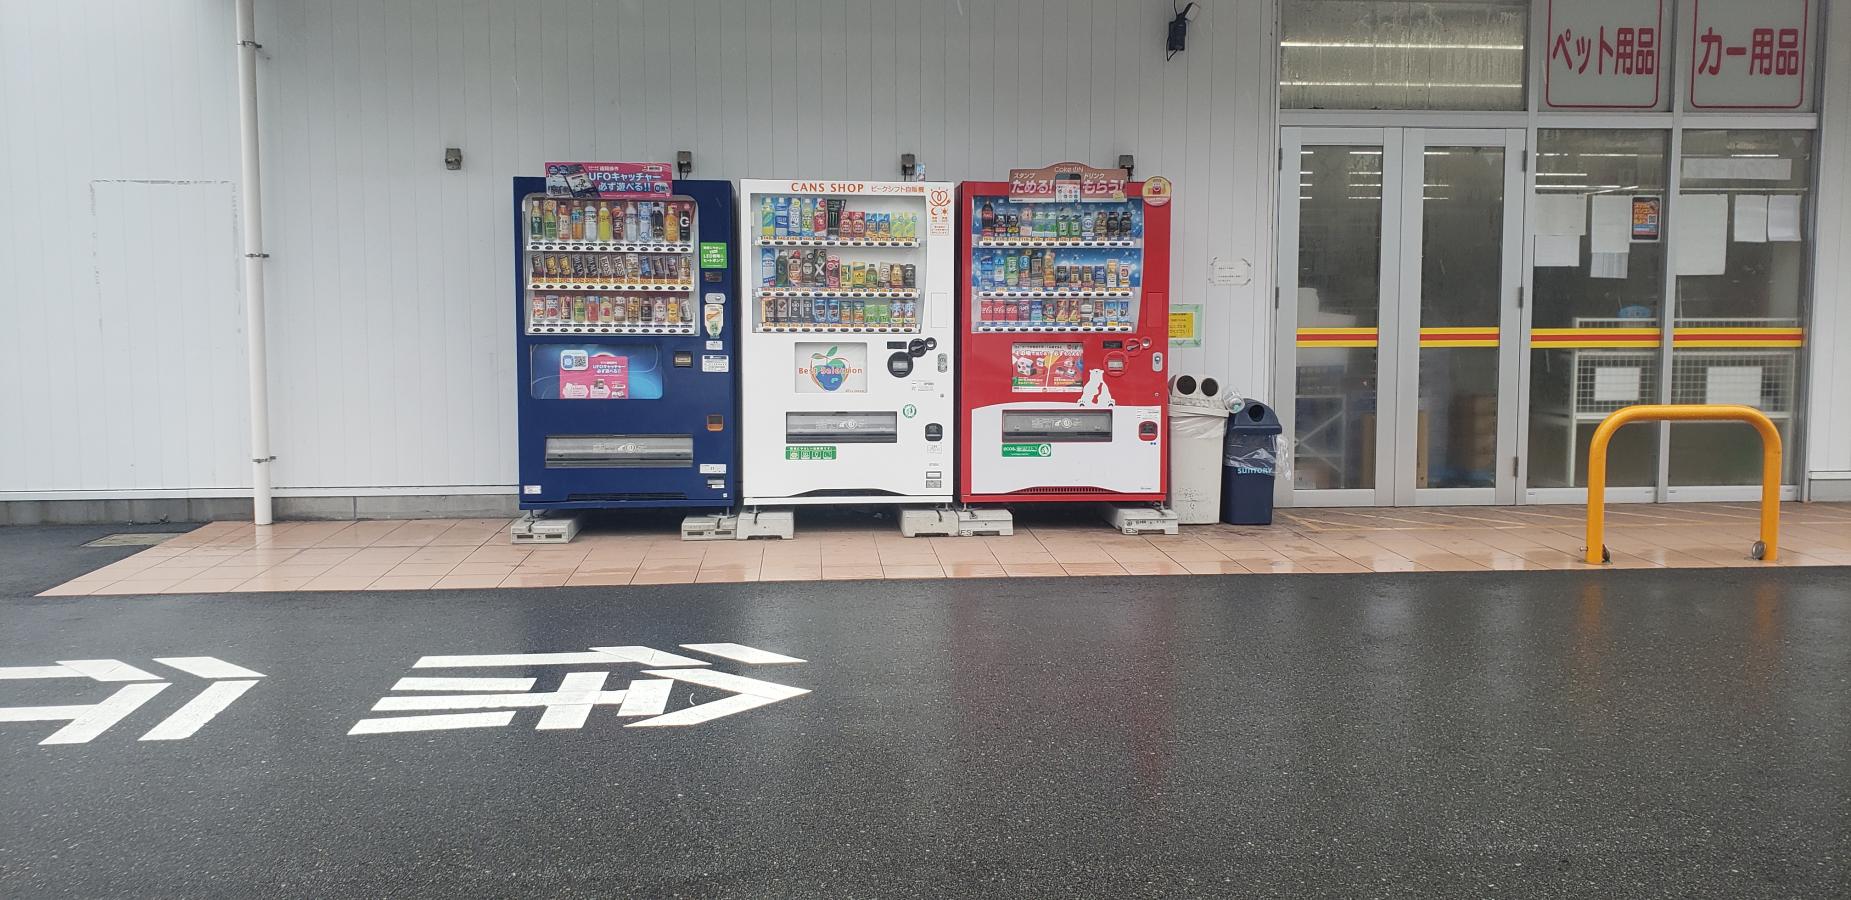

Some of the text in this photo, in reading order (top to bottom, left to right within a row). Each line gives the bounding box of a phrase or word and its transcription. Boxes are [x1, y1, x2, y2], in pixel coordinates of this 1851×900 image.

[1552, 25, 1654, 75] ペット用品
[1698, 27, 1799, 75] カー用品
[588, 172, 662, 181] UFOキャッチャー
[598, 182, 651, 192] 必ず遊べる!!
[791, 182, 865, 193] CANS SHOP
[1011, 179, 1054, 194] ためる!
[1082, 179, 1124, 194] もらう!
